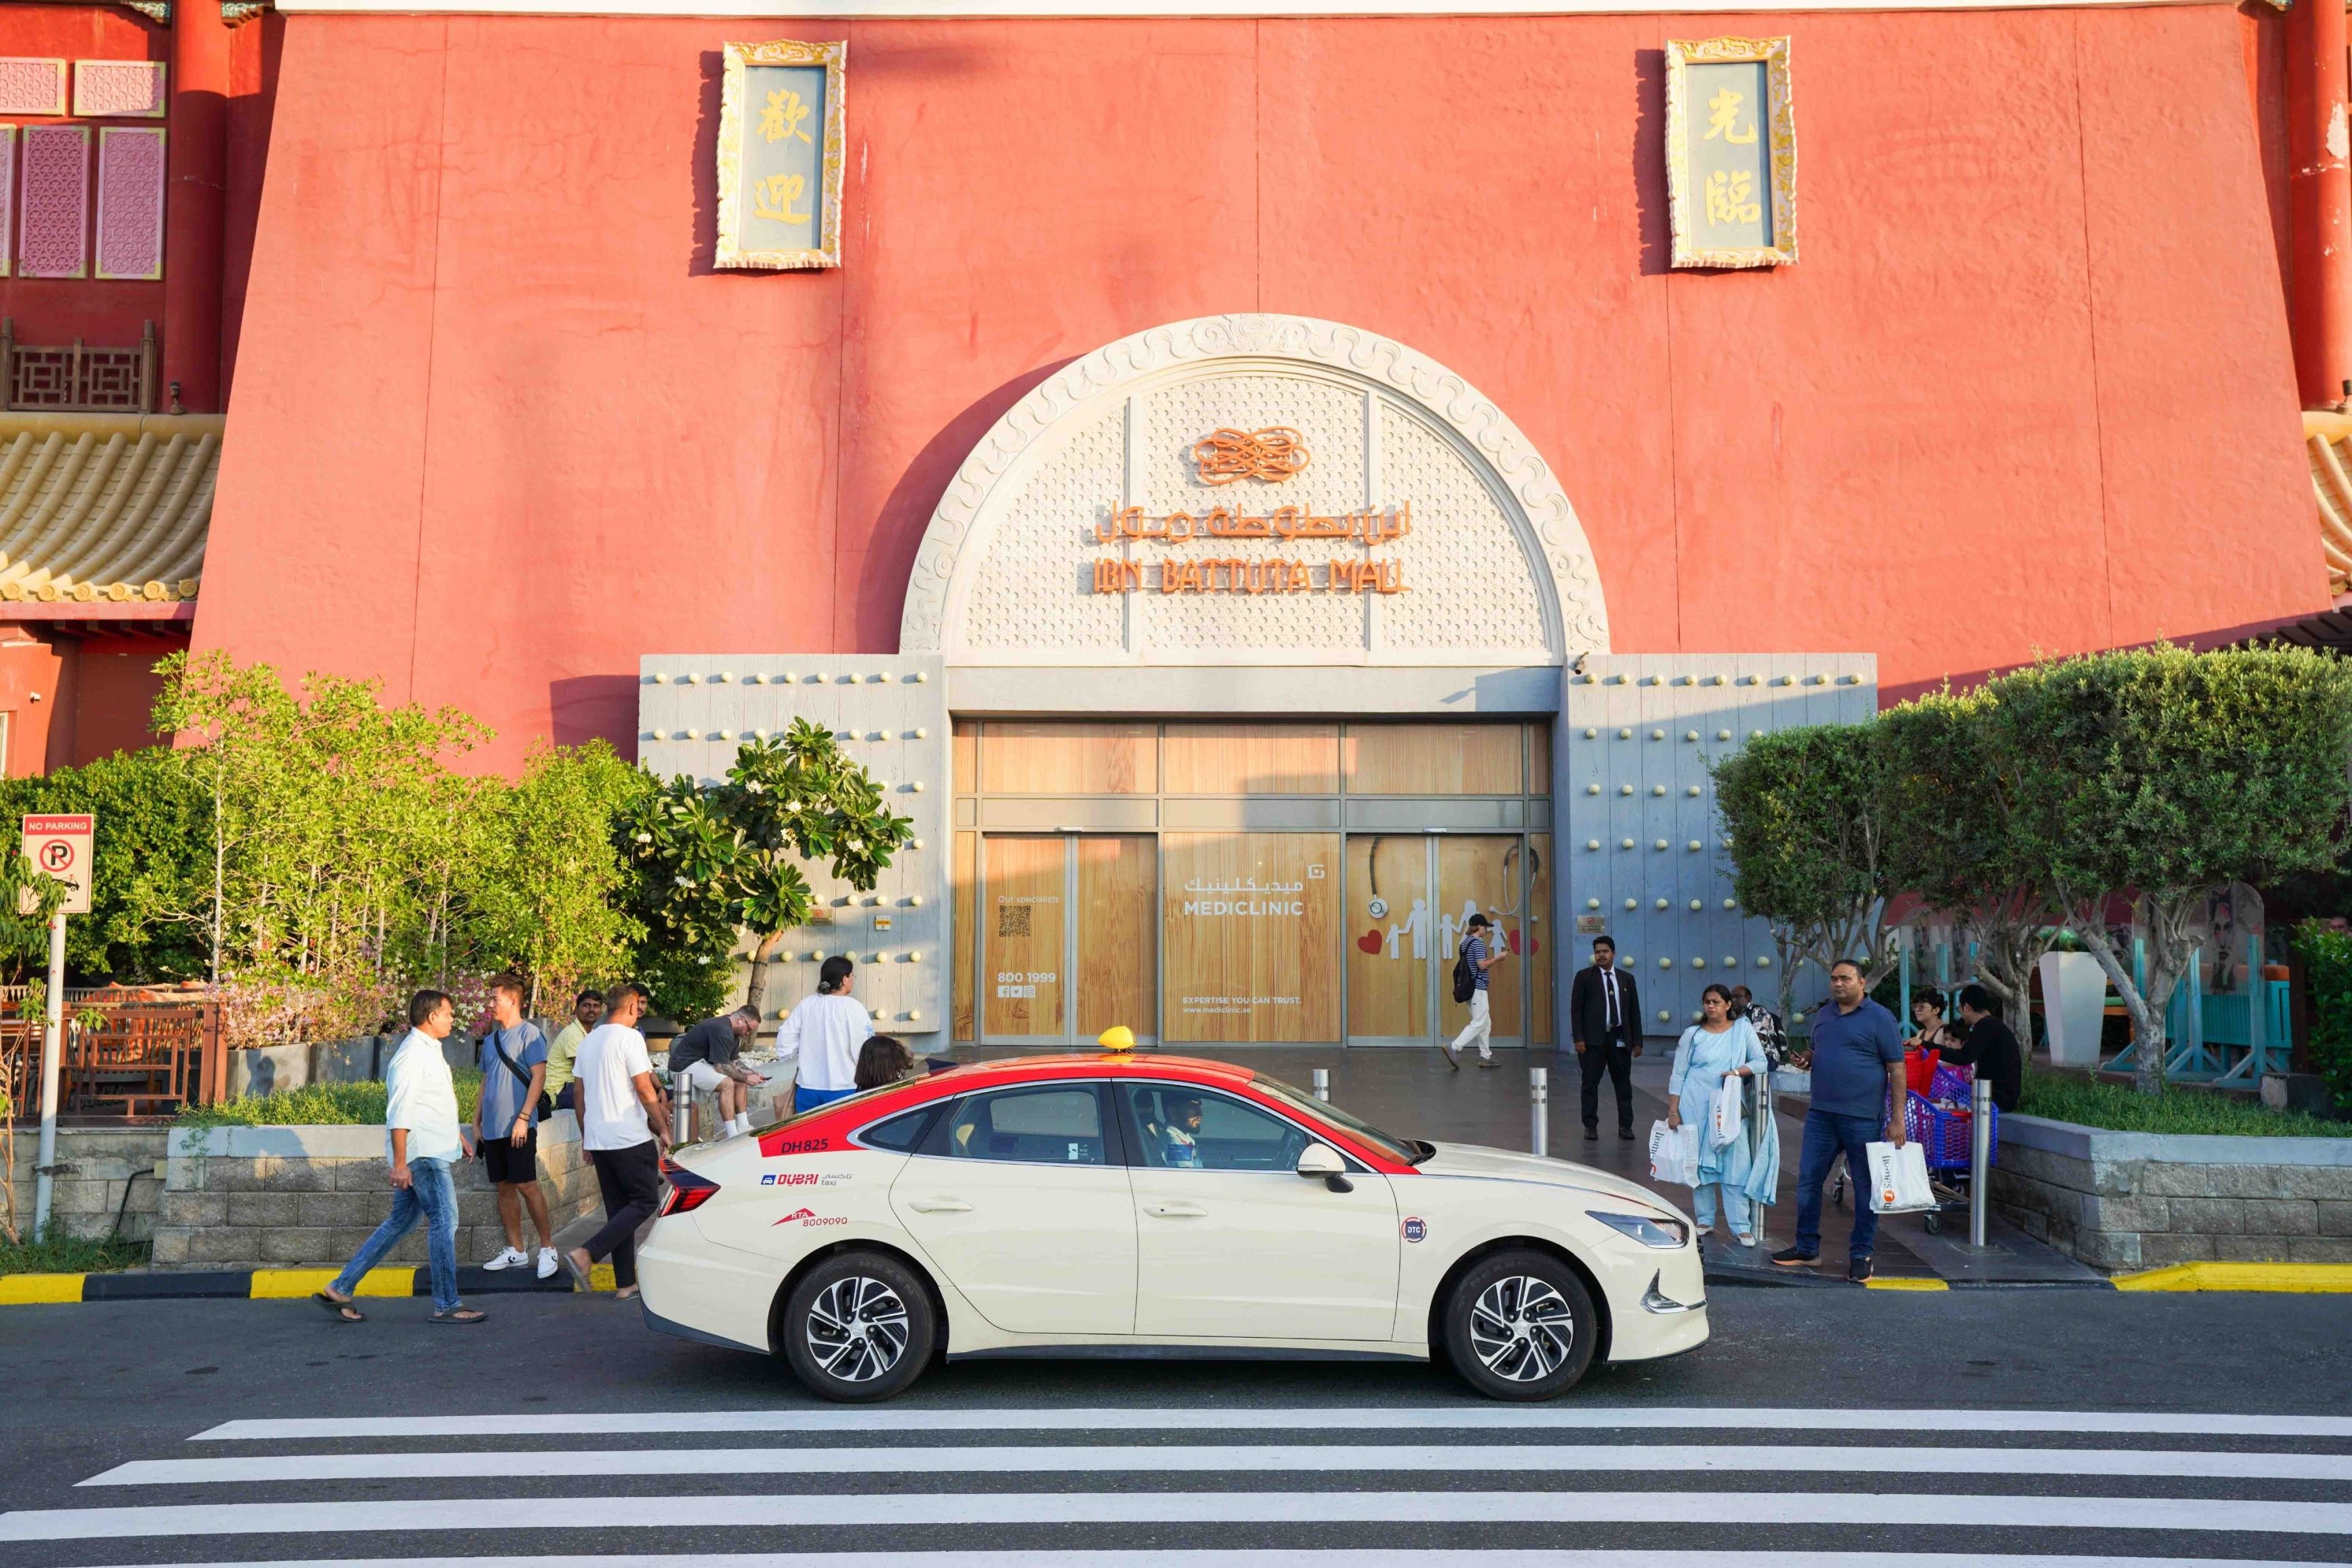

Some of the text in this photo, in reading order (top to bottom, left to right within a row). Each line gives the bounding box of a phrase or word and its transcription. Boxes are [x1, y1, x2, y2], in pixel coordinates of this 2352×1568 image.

[1095, 500, 1196, 544] مول
[1094, 558, 1412, 594] IBN BATTUTA MALL
[29, 822, 88, 831] NO PARKING
[998, 895, 1060, 904] Our specialists
[1184, 901, 1304, 916] MEDICLINIC
[997, 972, 1056, 983] 800 1999
[777, 1173, 819, 1187] DUBAI
[791, 1211, 809, 1220] RTA
[802, 1217, 848, 1227] 8009090
